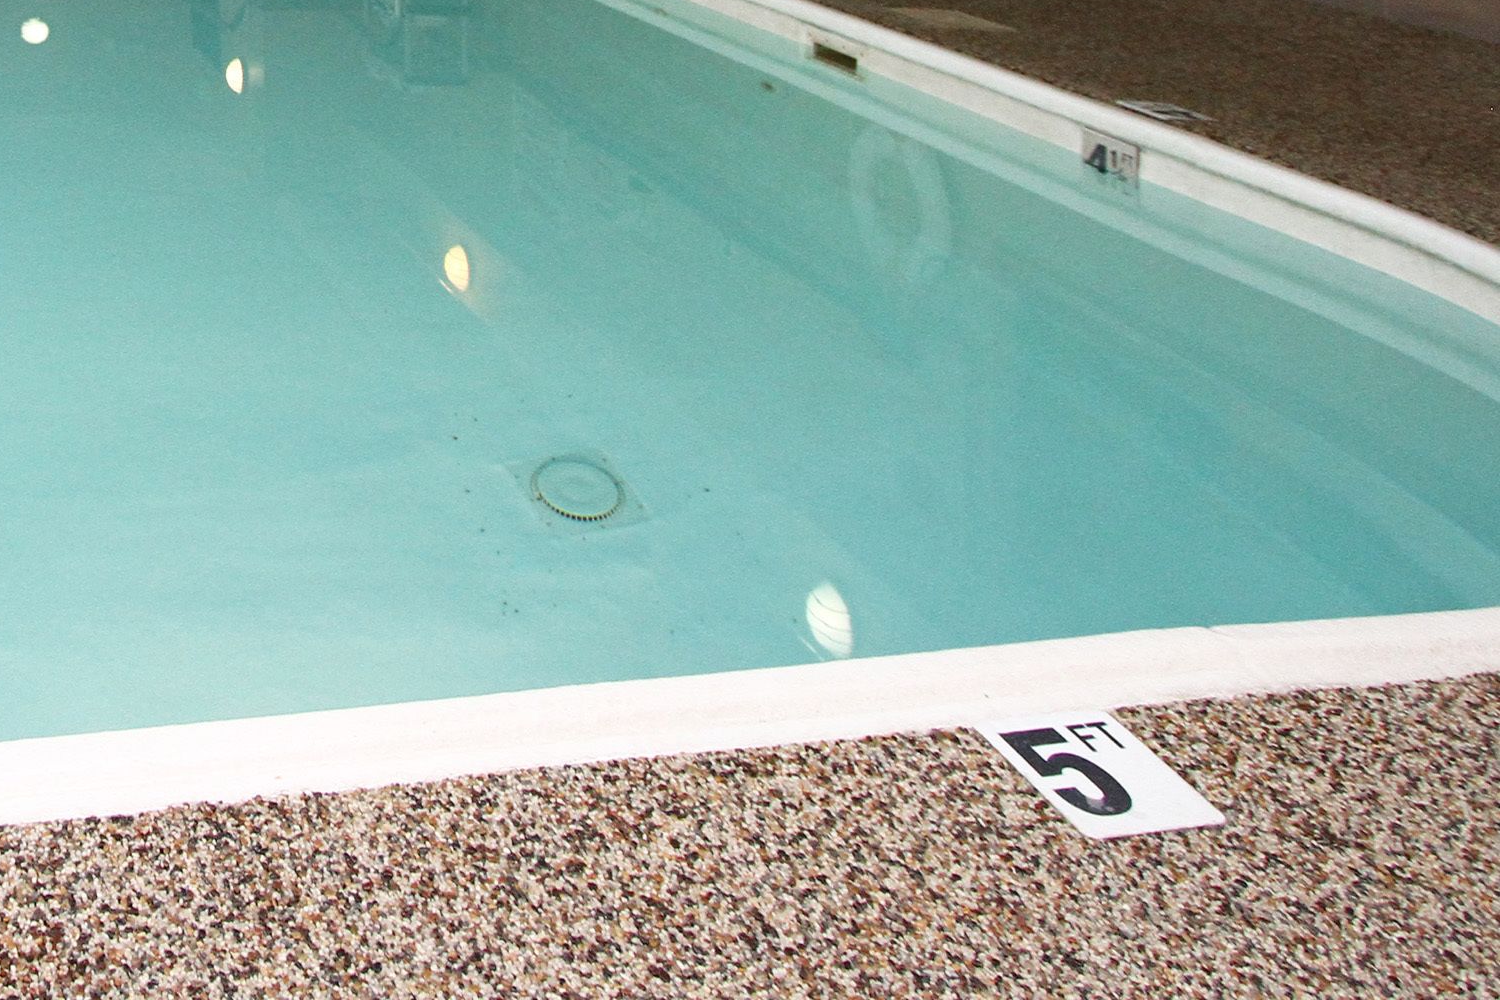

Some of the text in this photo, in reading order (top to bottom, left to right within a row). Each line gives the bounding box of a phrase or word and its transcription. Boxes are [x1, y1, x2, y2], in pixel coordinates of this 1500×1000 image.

[1084, 143, 1108, 174] 4
[997, 721, 1133, 817] 5 FT
